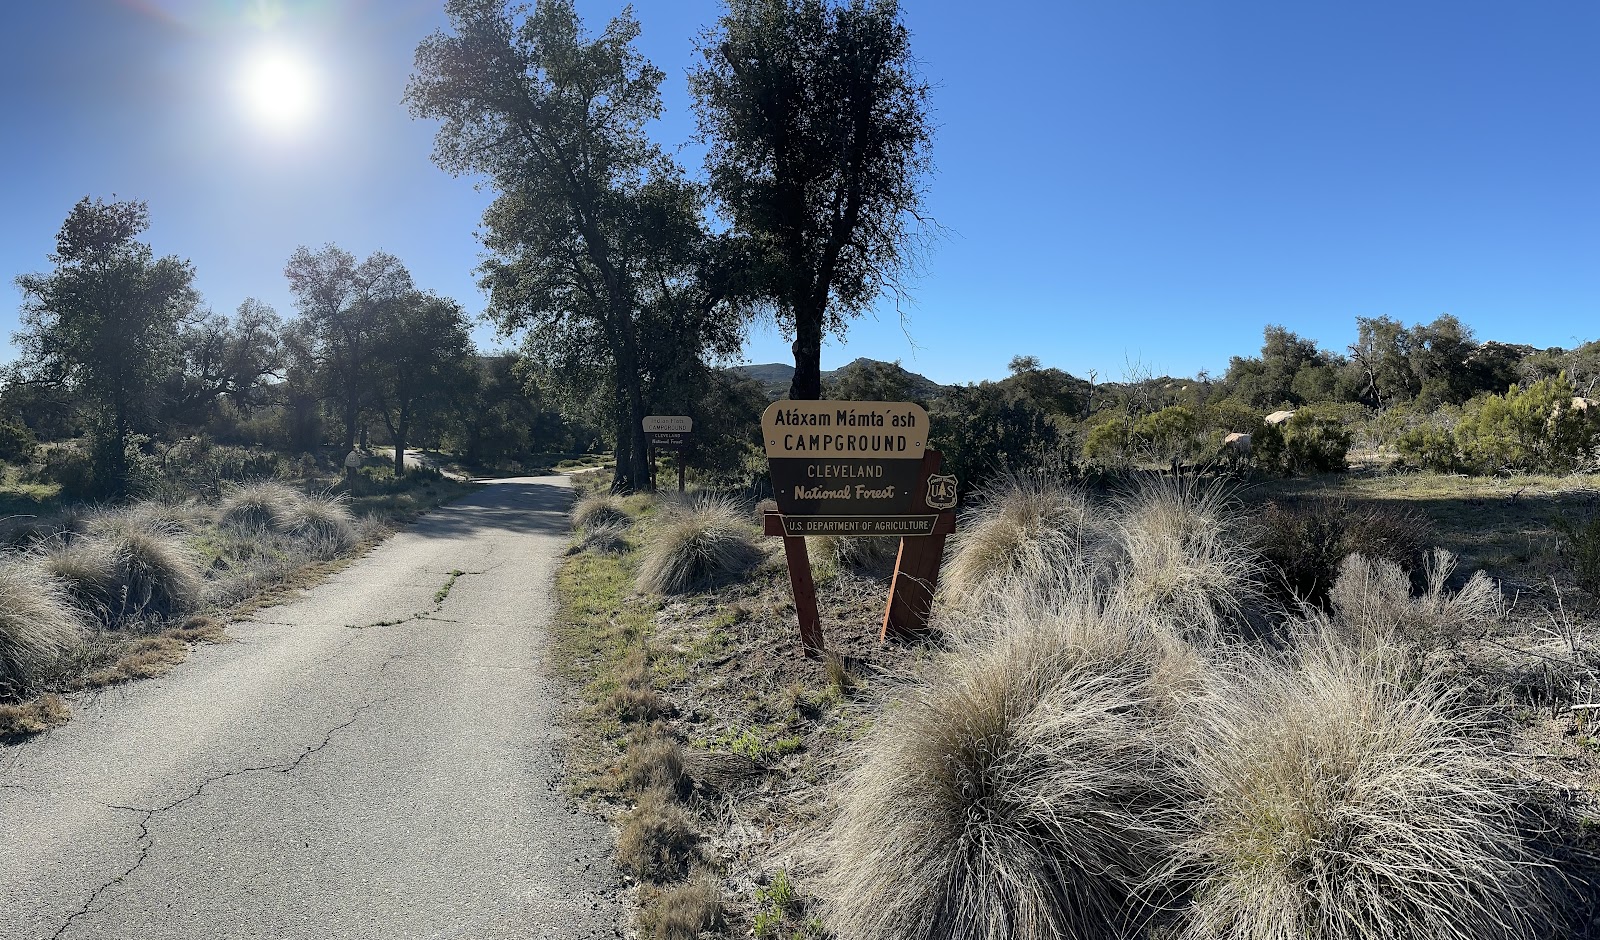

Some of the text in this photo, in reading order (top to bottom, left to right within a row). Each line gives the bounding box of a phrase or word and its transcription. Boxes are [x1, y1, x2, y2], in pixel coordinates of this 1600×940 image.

[775, 409, 831, 426] Atáxam
[784, 434, 907, 452] CAMPGROUND
[807, 464, 884, 478] CLEVELAND
[794, 484, 896, 500] National Forest
[806, 520, 860, 531] DEPARTMENT
[861, 520, 873, 531] OF
[874, 520, 929, 531] AGRICULTURE
